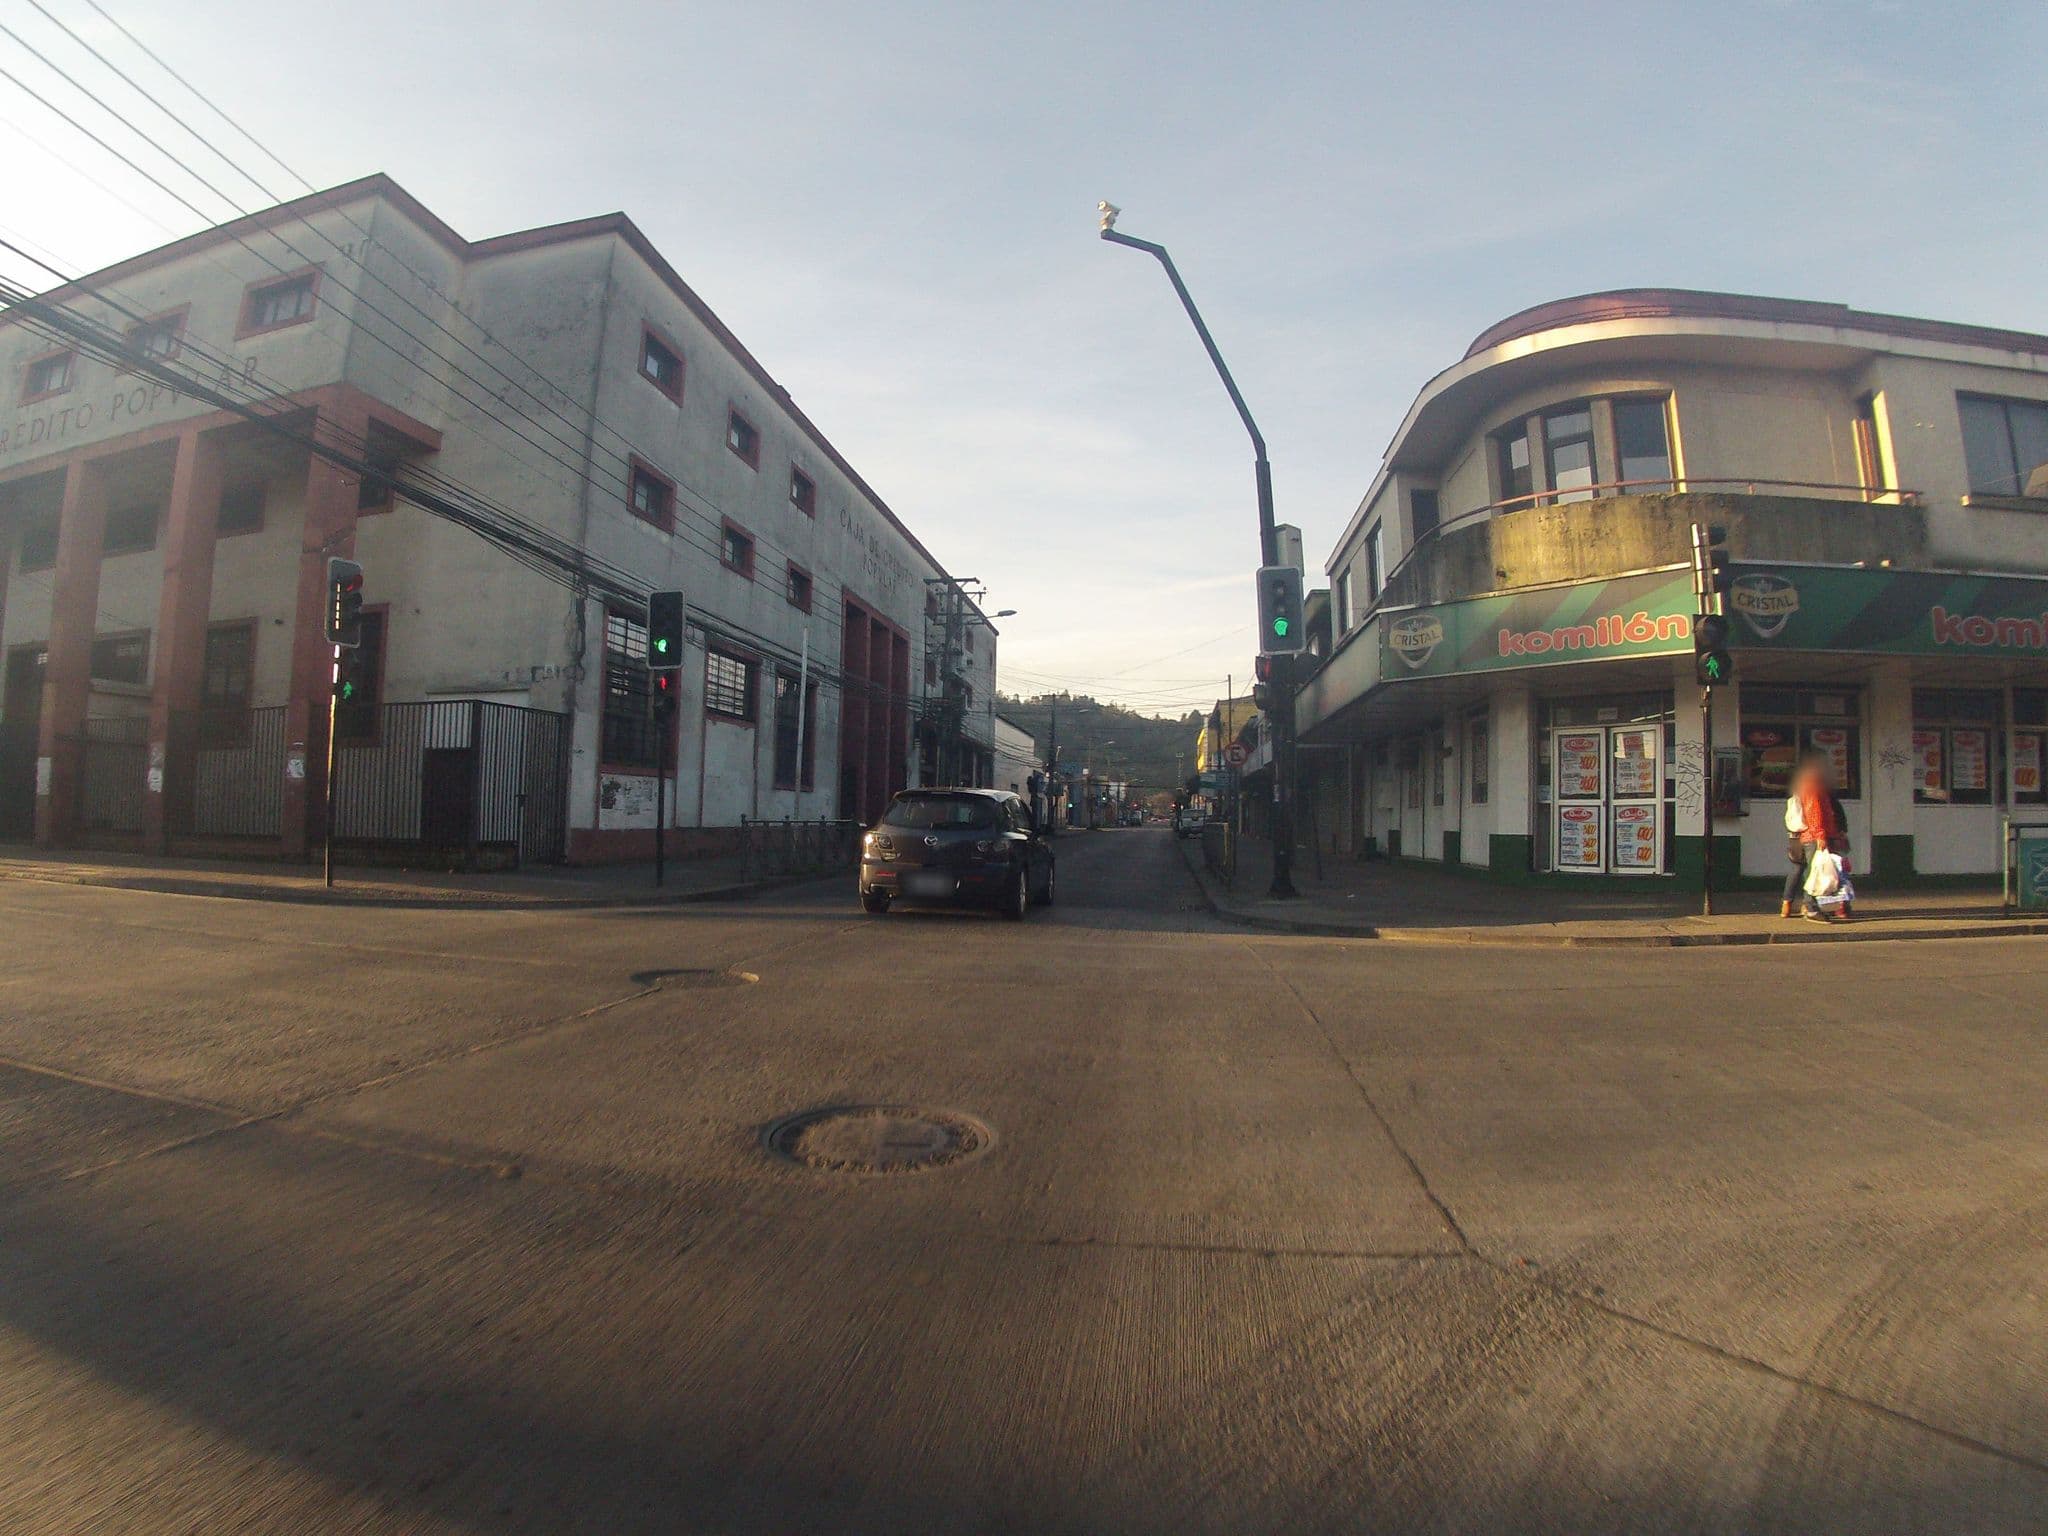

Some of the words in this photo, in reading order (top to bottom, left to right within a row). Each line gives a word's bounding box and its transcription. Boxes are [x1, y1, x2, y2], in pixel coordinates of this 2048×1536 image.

[840, 509, 864, 545] CAJA
[869, 535, 880, 558] DE
[1737, 592, 1794, 610] CRISTAL
[1394, 630, 1440, 646] CRISTAL
[1498, 611, 1689, 656] komilón
